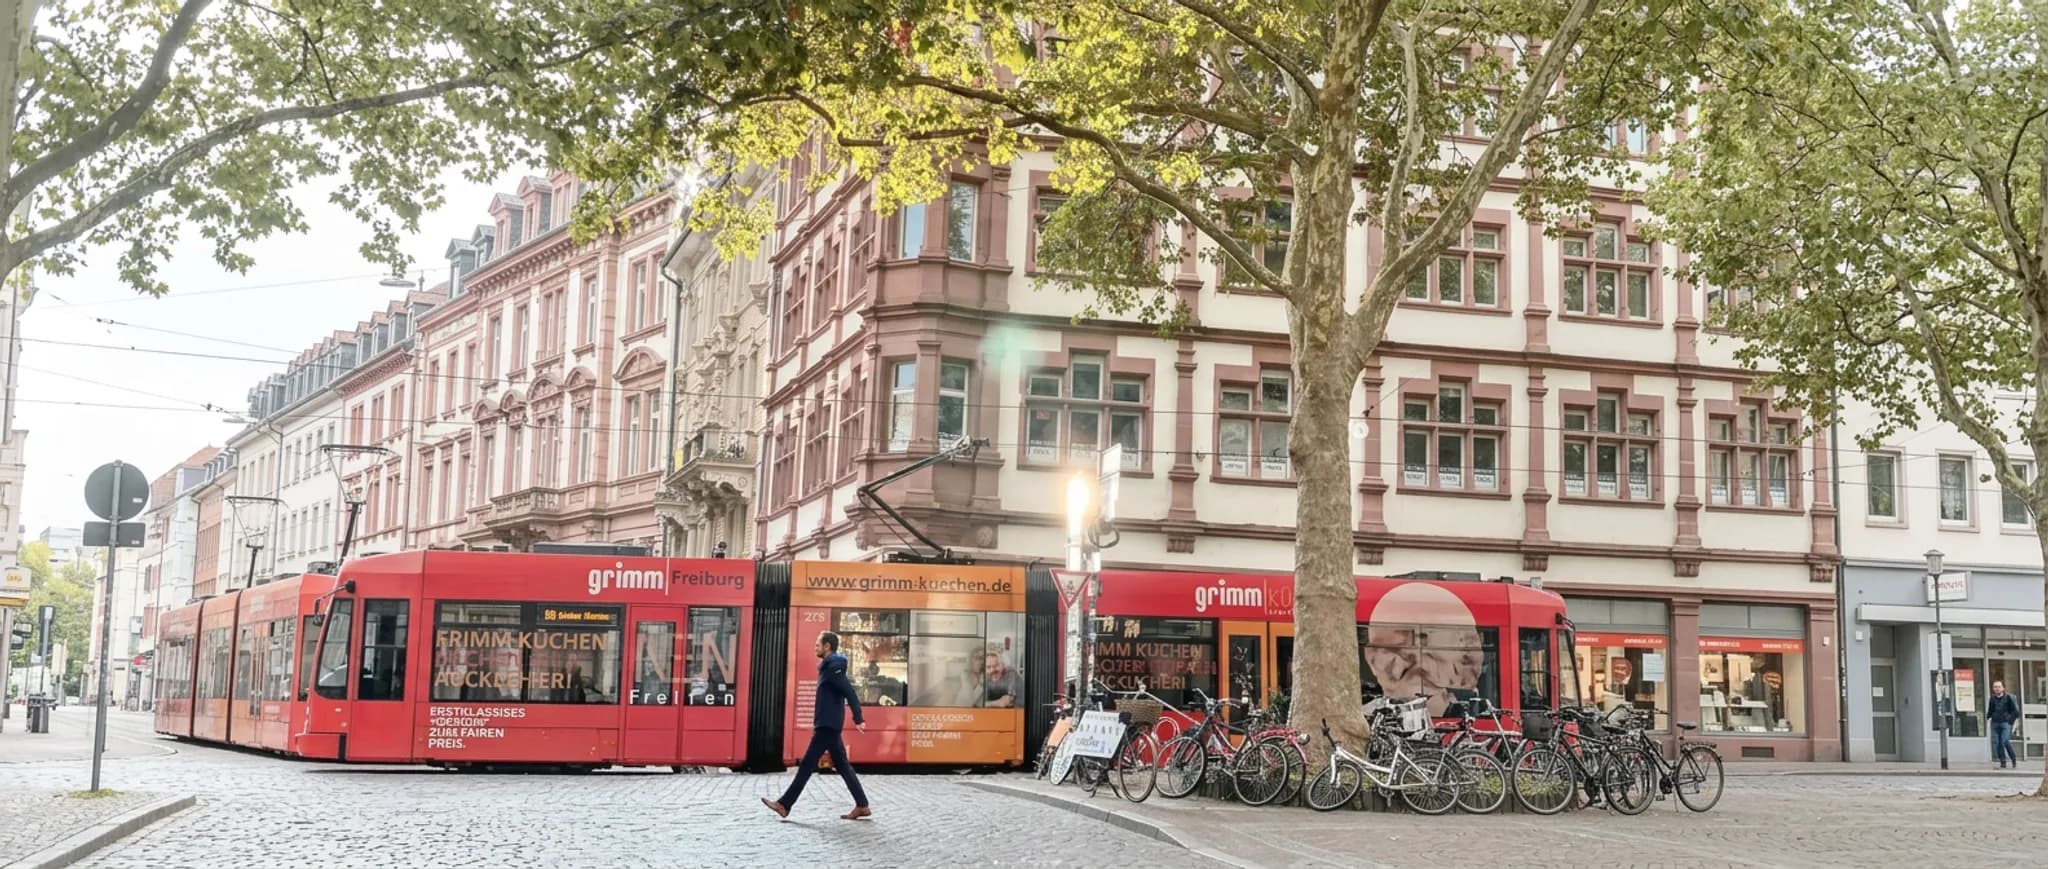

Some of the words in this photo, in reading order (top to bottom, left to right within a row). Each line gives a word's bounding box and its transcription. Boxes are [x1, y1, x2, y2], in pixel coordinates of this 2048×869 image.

[588, 561, 664, 595] grimm
[671, 570, 745, 590] Freiburg
[1195, 578, 1263, 612] grimm
[460, 728, 504, 738] FAIREN
[428, 738, 466, 749] PREIS.
